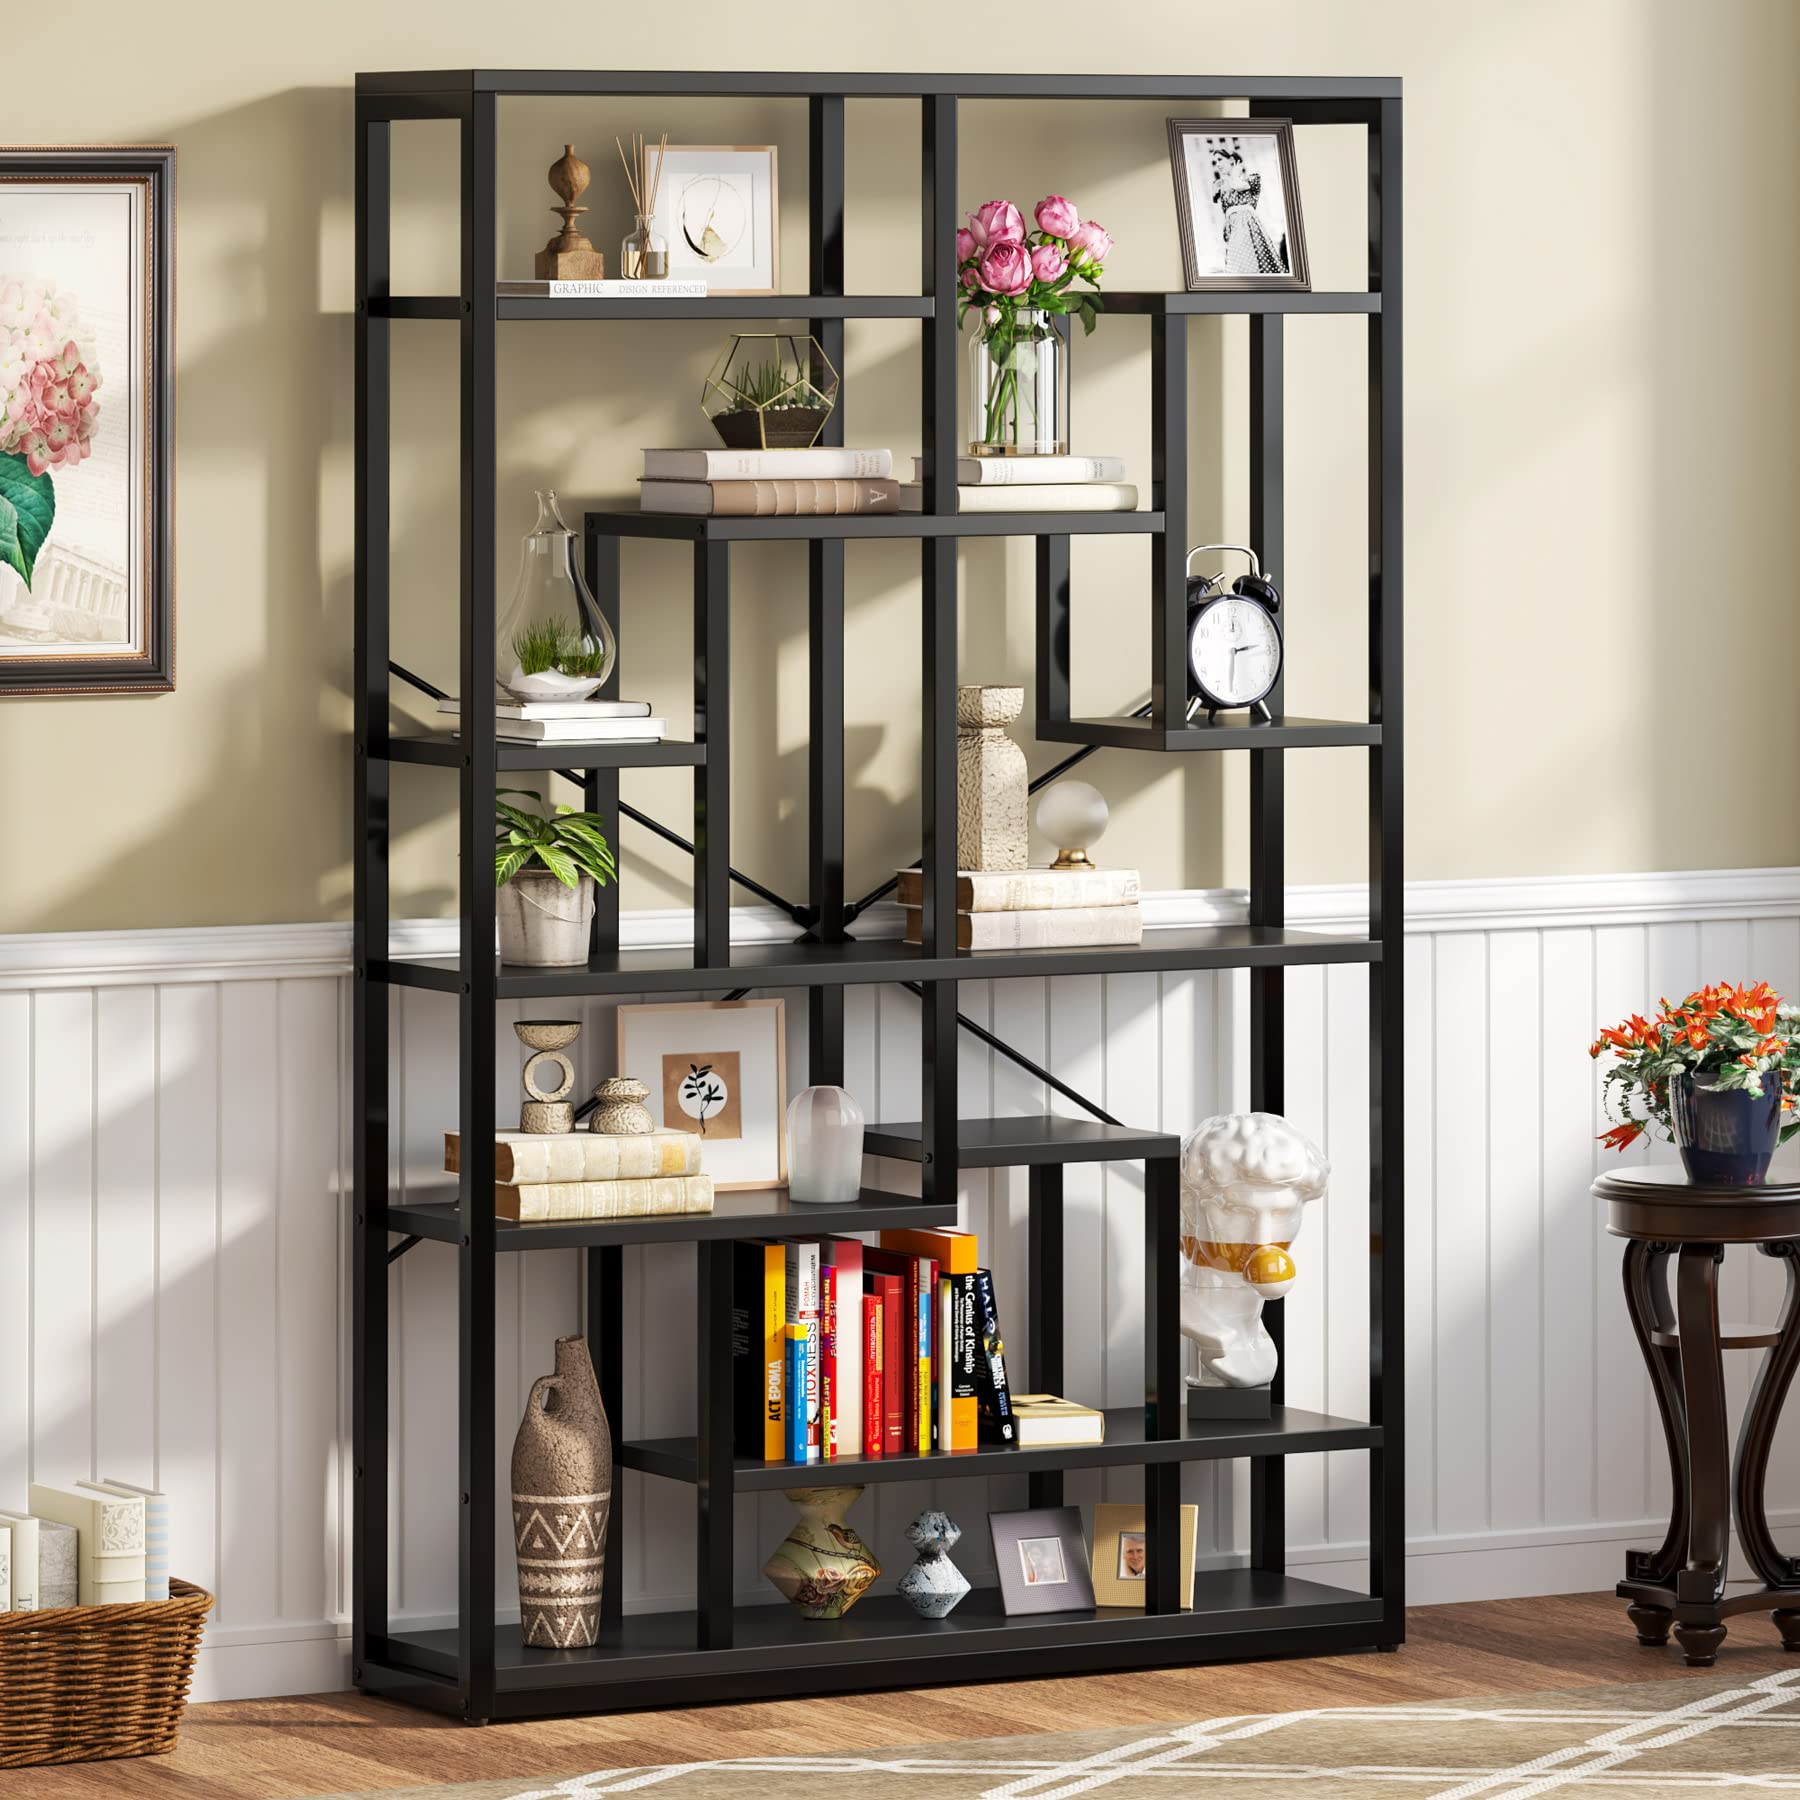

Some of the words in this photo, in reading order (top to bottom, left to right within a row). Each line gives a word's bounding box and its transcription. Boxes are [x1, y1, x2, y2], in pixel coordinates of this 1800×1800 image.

[553, 282, 604, 295] GRAPHIC
[651, 284, 706, 295] REFERENCED
[869, 488, 888, 505] A
[1212, 612, 1220, 625] 11
[1228, 606, 1237, 618] 12
[1200, 626, 1209, 639] 10
[1194, 646, 1201, 658] 9
[1264, 644, 1272, 656] 3
[1200, 666, 1208, 678] 8
[1214, 680, 1221, 691] 7
[965, 1275, 975, 1290] the
[965, 1292, 975, 1324] Genius
[979, 1276, 996, 1335] HALO
[965, 1326, 975, 1337] of
[963, 1339, 975, 1374] Kinship
[768, 1360, 782, 1422] АСТЕРОИД
